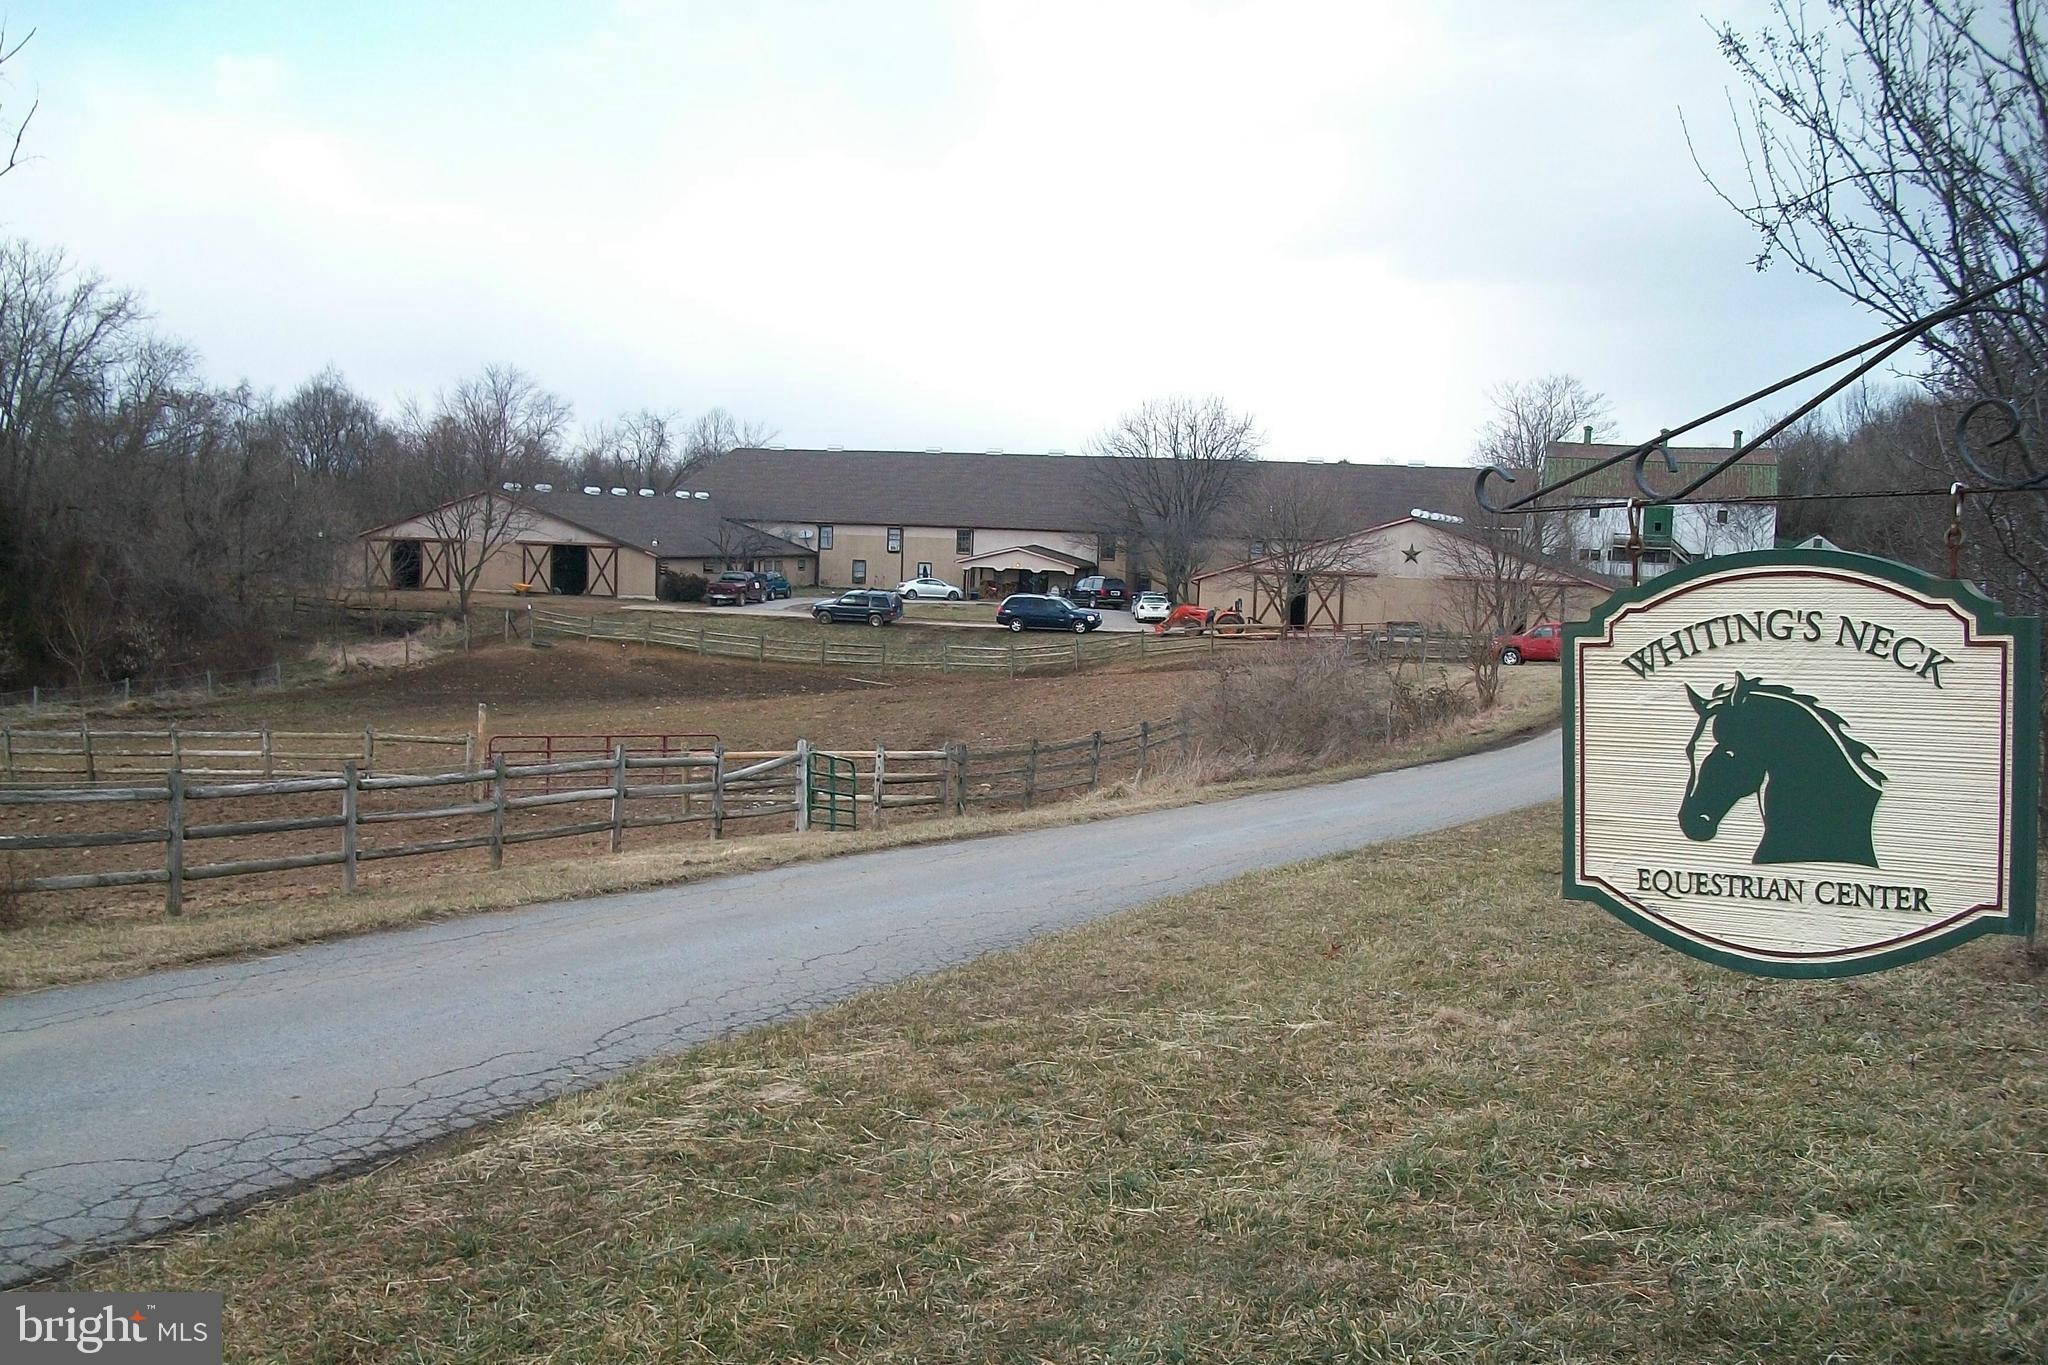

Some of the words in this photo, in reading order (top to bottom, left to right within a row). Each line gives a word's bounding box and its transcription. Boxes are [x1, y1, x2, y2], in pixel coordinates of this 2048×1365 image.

[1621, 609, 1823, 680] WHITING'S
[1835, 615, 1955, 689] NECK
[1637, 868, 1804, 902] EQUESTRIAN
[1814, 881, 1933, 913] CENTER
